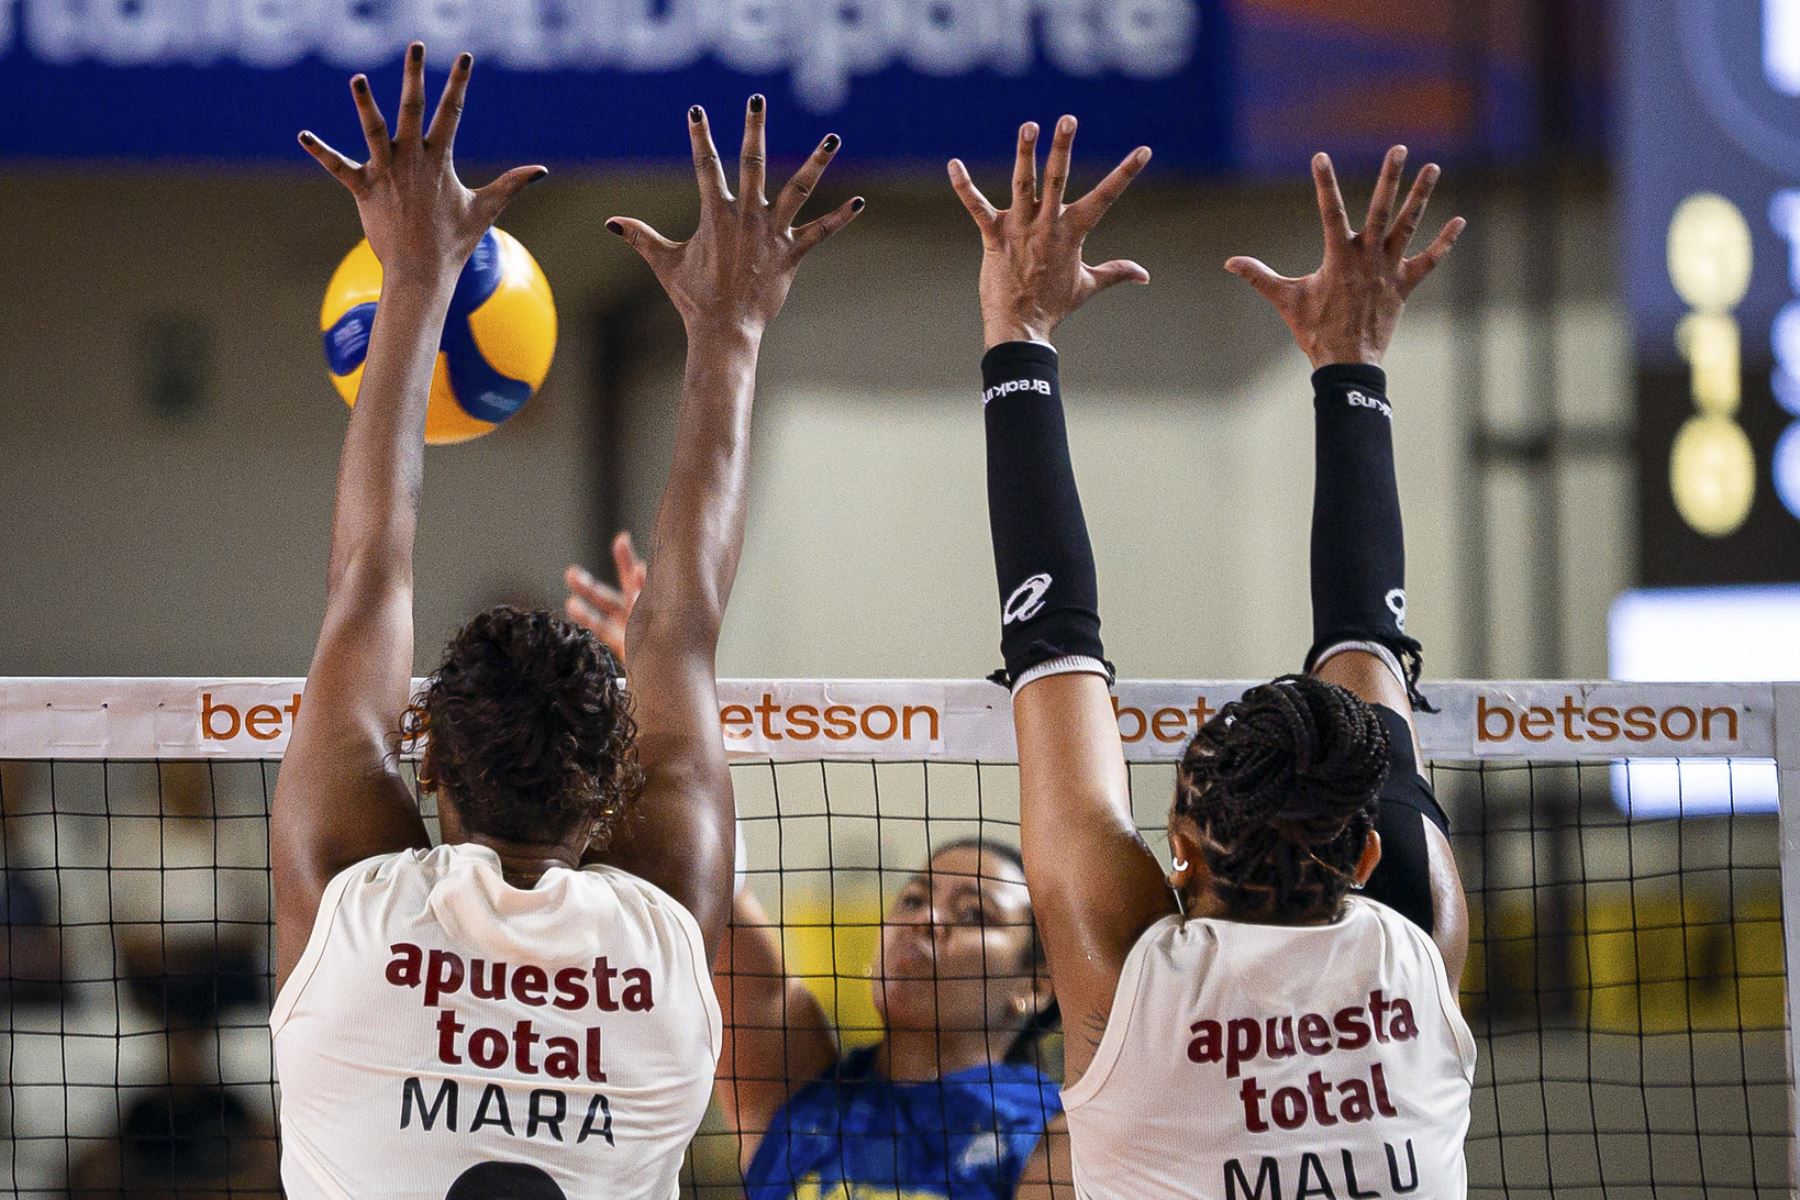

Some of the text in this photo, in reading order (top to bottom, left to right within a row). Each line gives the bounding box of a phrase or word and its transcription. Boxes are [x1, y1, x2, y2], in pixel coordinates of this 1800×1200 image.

[982, 379, 1051, 405] Breakin
[719, 693, 940, 741] etsson
[1476, 694, 1738, 743] betsson
[385, 942, 654, 1013] apuesta
[436, 1009, 608, 1083] total
[1186, 989, 1419, 1079] apuesta
[399, 1076, 616, 1148] MARA
[1239, 1061, 1398, 1134] total
[1223, 1138, 1419, 1200] MALU
